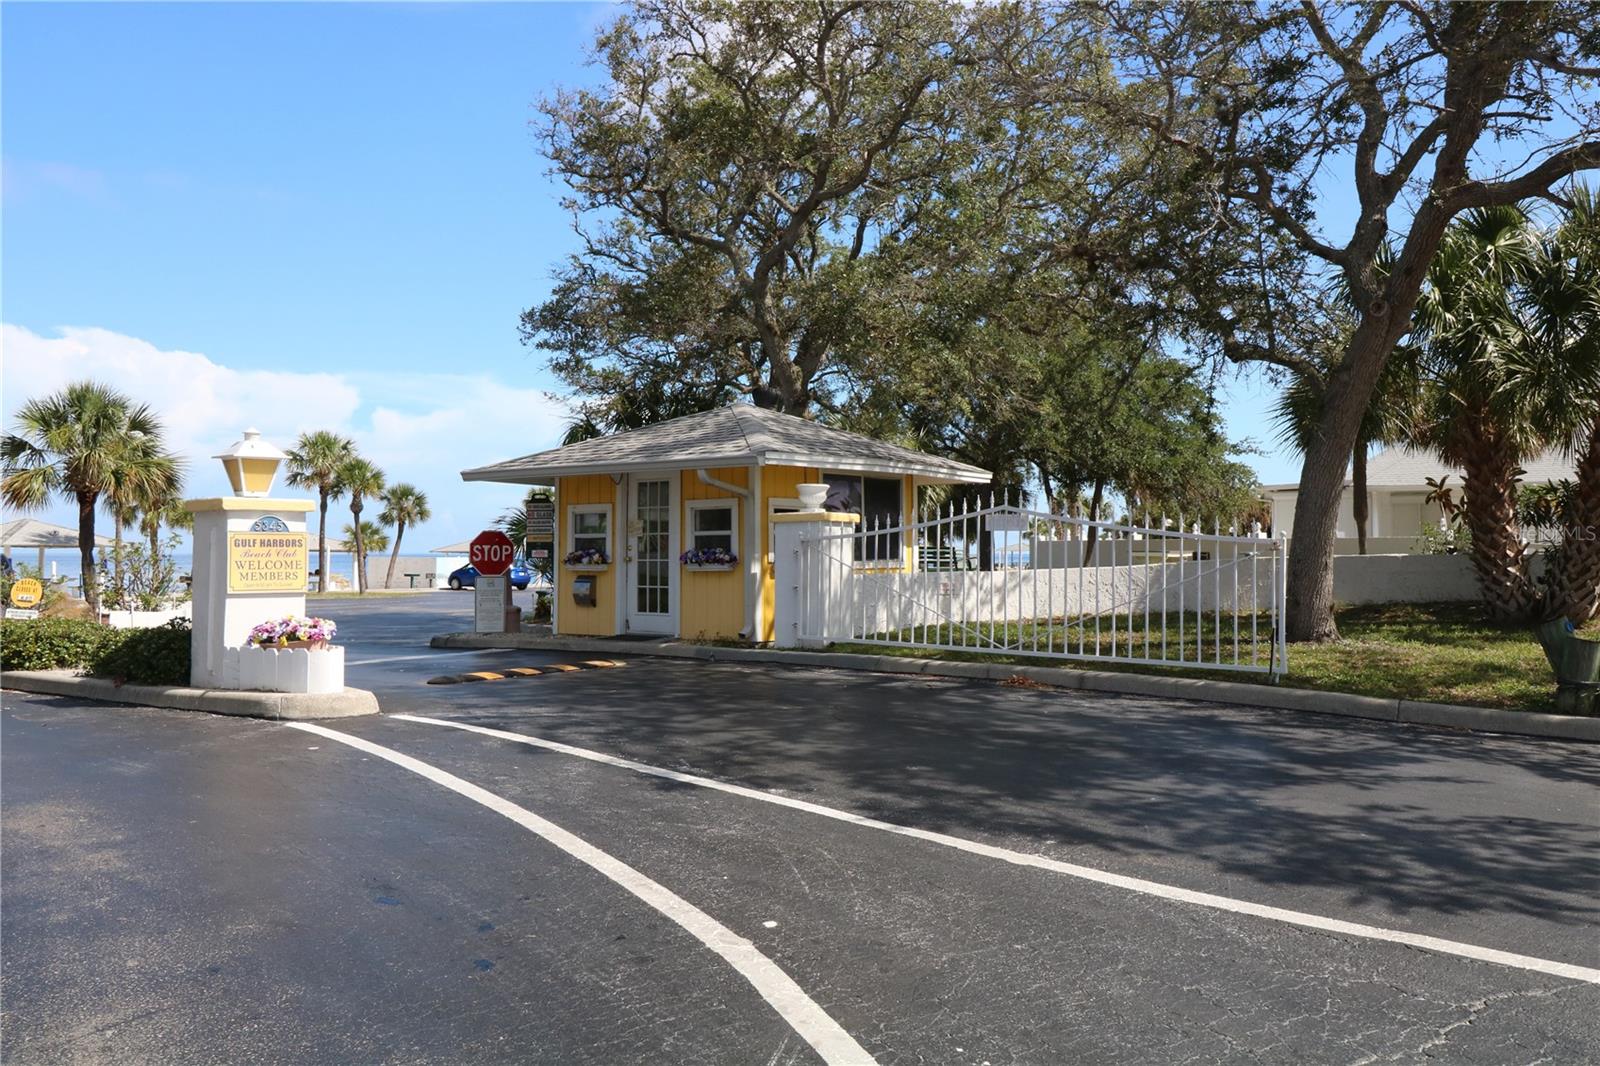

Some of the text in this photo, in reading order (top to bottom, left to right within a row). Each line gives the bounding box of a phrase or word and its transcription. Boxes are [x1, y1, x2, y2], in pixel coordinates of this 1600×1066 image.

[234, 539, 303, 548] GULF HARBORS
[240, 549, 298, 558] Beach Club
[472, 545, 511, 562] STOP
[235, 560, 303, 570] WELCOME
[239, 571, 299, 581] MEMBERS
